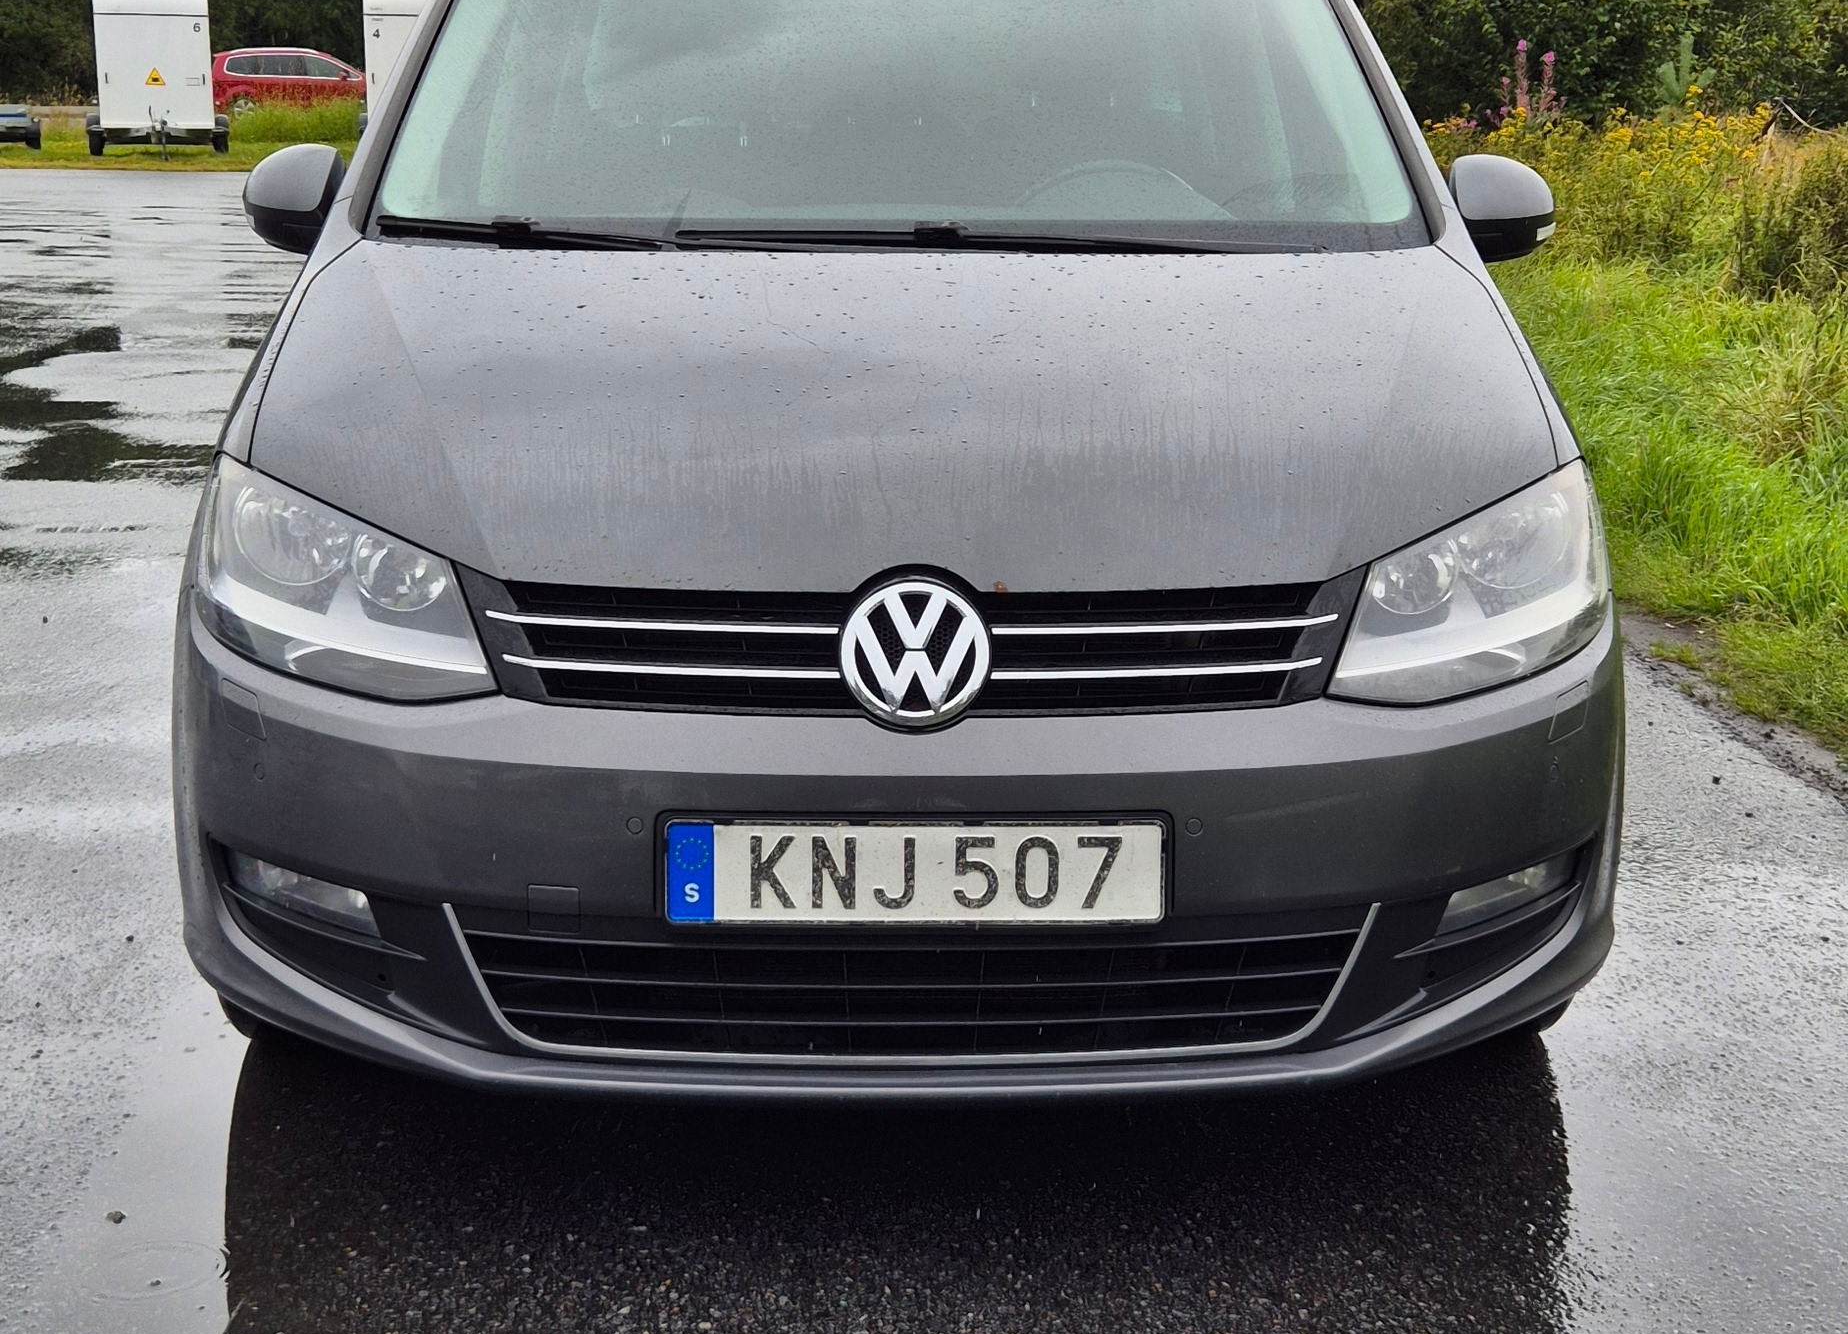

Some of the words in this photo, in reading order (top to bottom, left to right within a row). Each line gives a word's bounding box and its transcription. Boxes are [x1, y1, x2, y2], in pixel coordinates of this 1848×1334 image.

[193, 22, 201, 33] 6
[372, 28, 381, 39] 4
[845, 583, 985, 720] VW
[749, 834, 917, 910] KNJ
[952, 835, 1123, 910] 507
[684, 882, 700, 903] S
